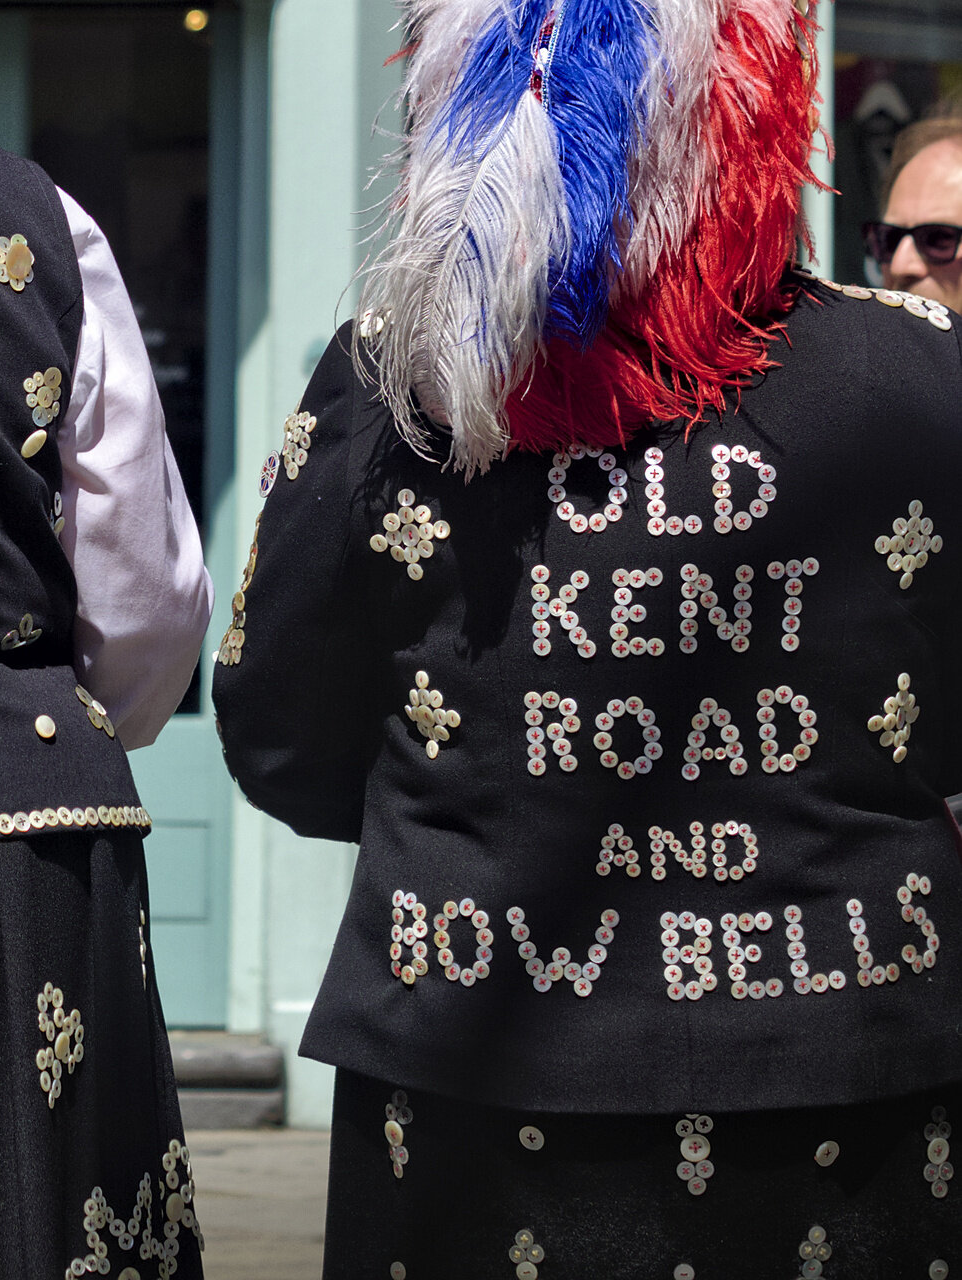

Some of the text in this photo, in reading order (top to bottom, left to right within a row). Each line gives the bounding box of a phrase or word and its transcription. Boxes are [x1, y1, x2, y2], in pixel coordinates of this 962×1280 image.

[548, 443, 777, 535] OLD
[531, 557, 819, 658] KENT
[524, 685, 819, 780] ROAD
[595, 821, 758, 881] AND
[390, 872, 939, 1001] BOW BELLS
